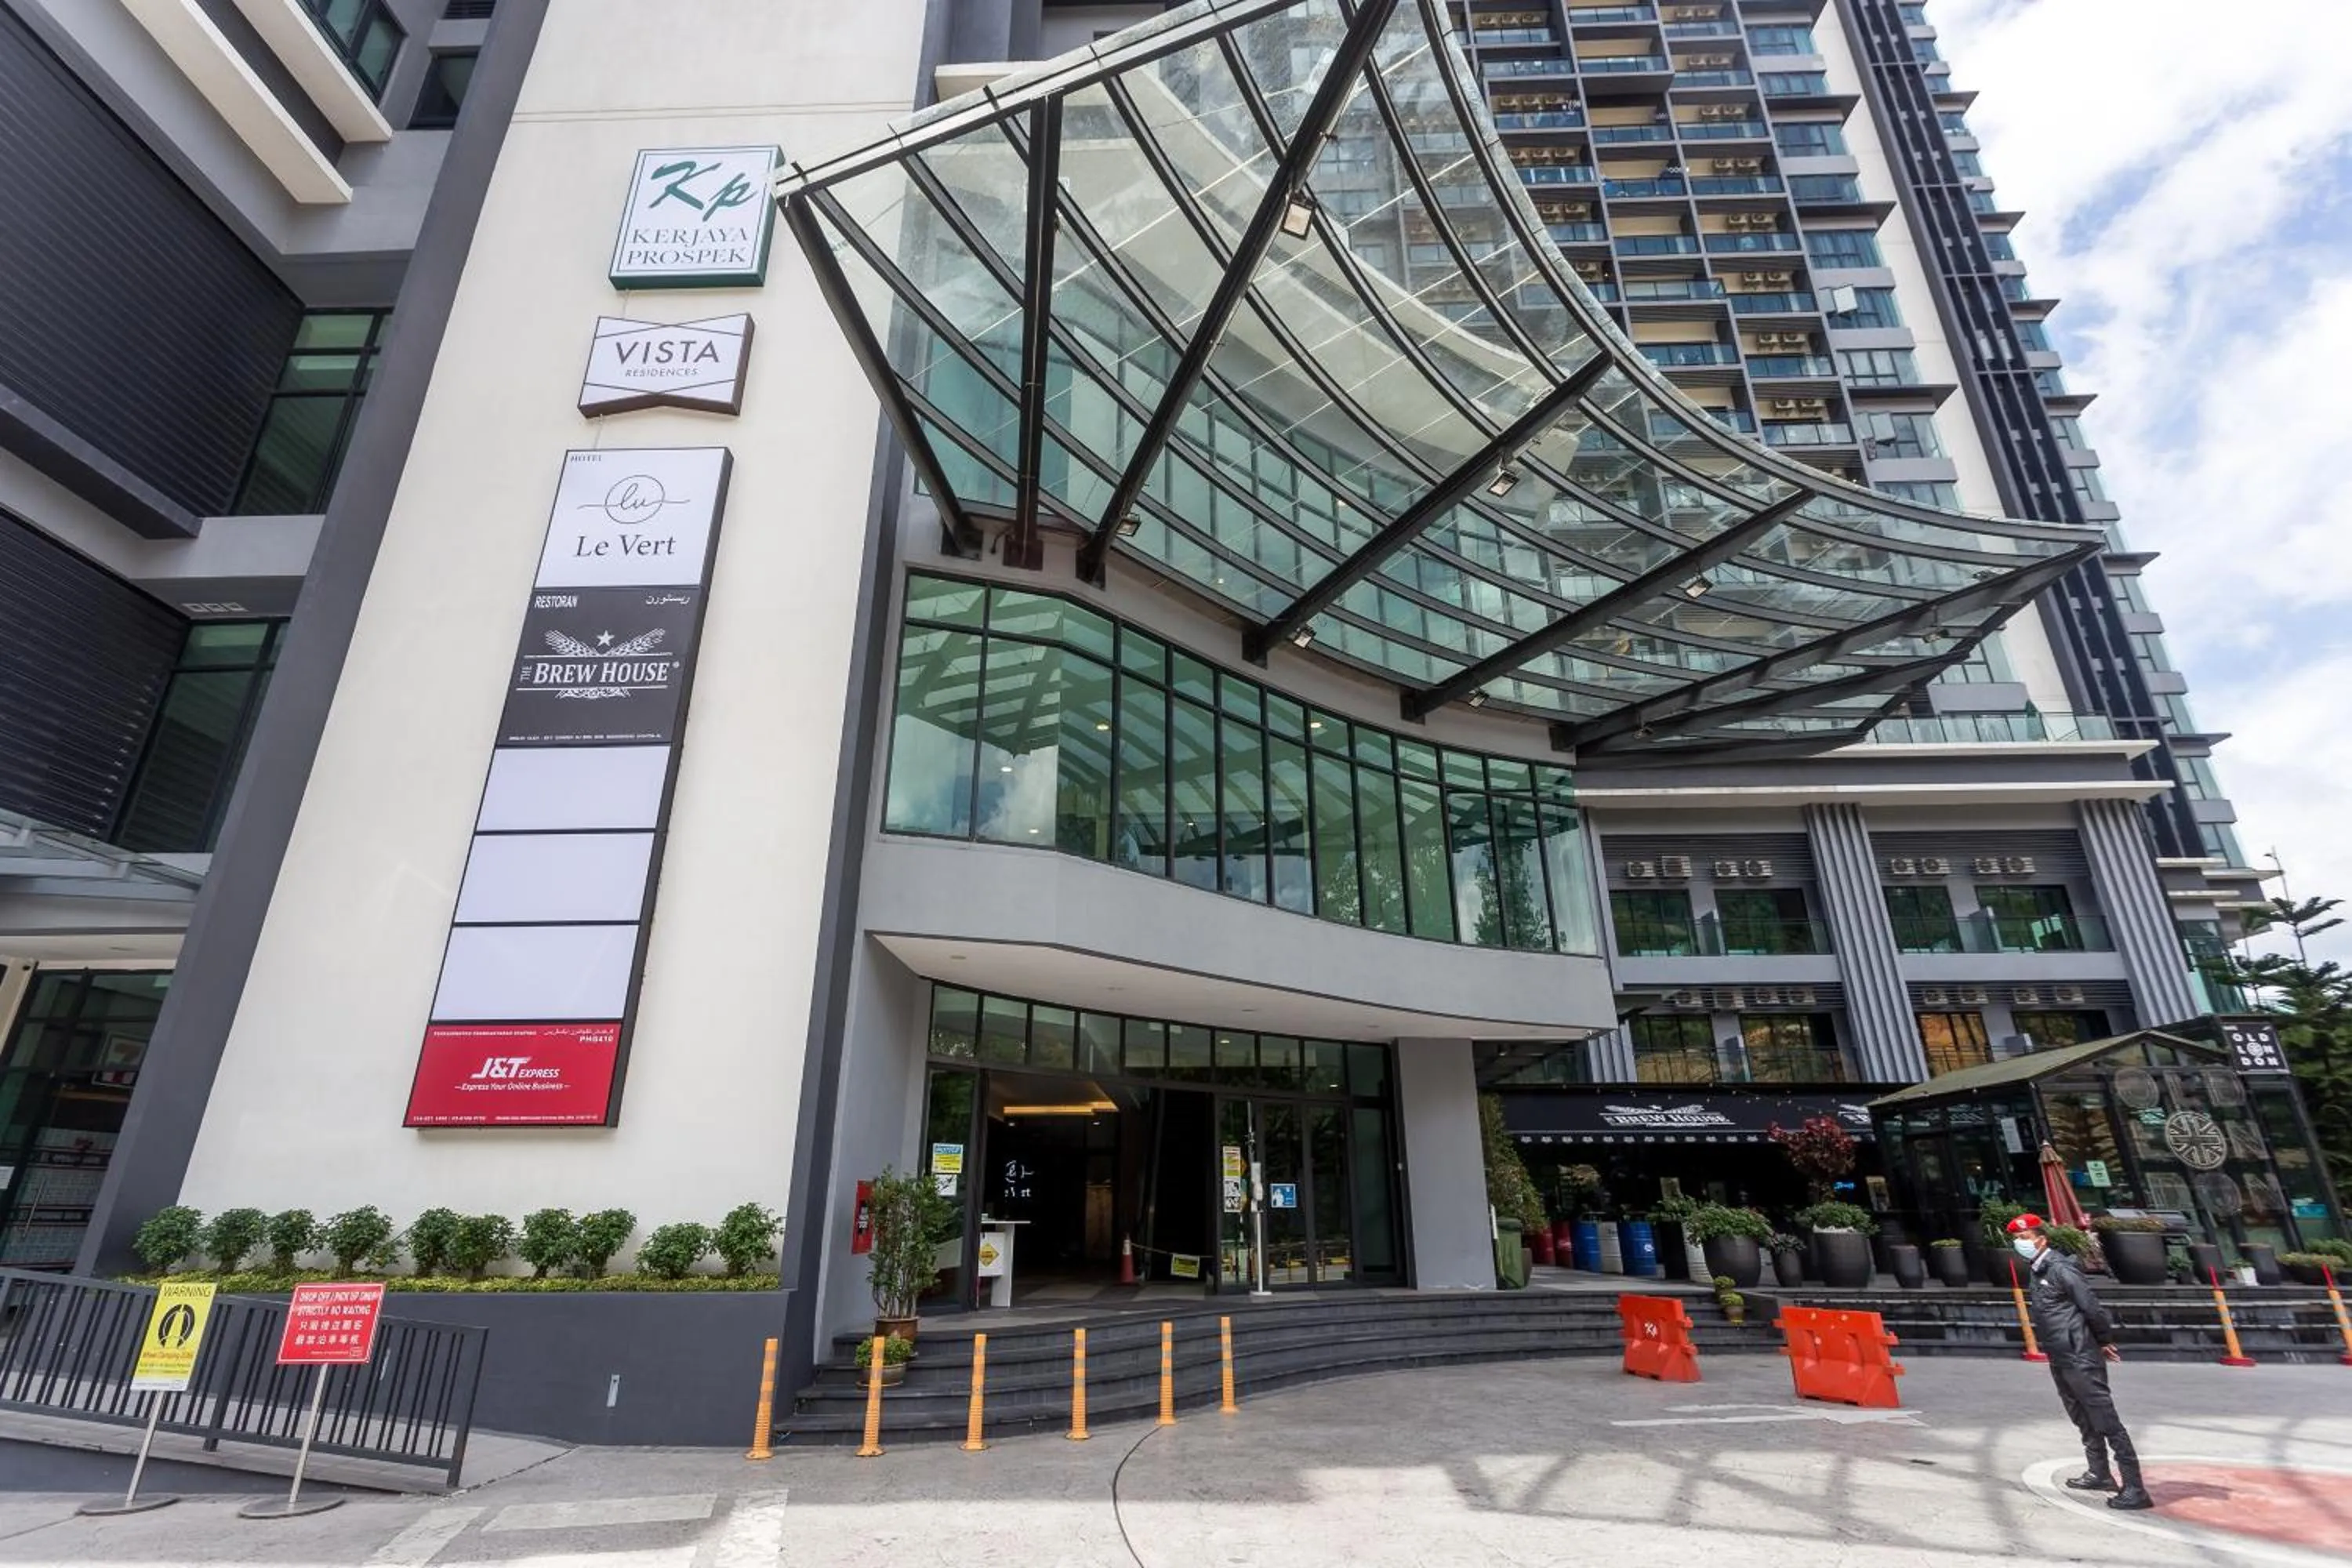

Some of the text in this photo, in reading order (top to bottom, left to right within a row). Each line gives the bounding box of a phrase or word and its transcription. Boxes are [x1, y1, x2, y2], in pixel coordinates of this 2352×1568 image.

[630, 227, 748, 247] KERJAYA
[627, 246, 746, 265] PROSPEK
[615, 339, 720, 365] VISTA
[625, 367, 699, 378] RESIDENCES
[573, 534, 677, 557] Le Vert
[534, 595, 579, 608] RESTORAN
[520, 661, 670, 684] THE BREW HOUSE
[2231, 1032, 2270, 1043] OLD
[470, 1056, 561, 1080] J&T EXPRESS
[2240, 1055, 2279, 1066] DON
[163, 1285, 212, 1298] WARNING
